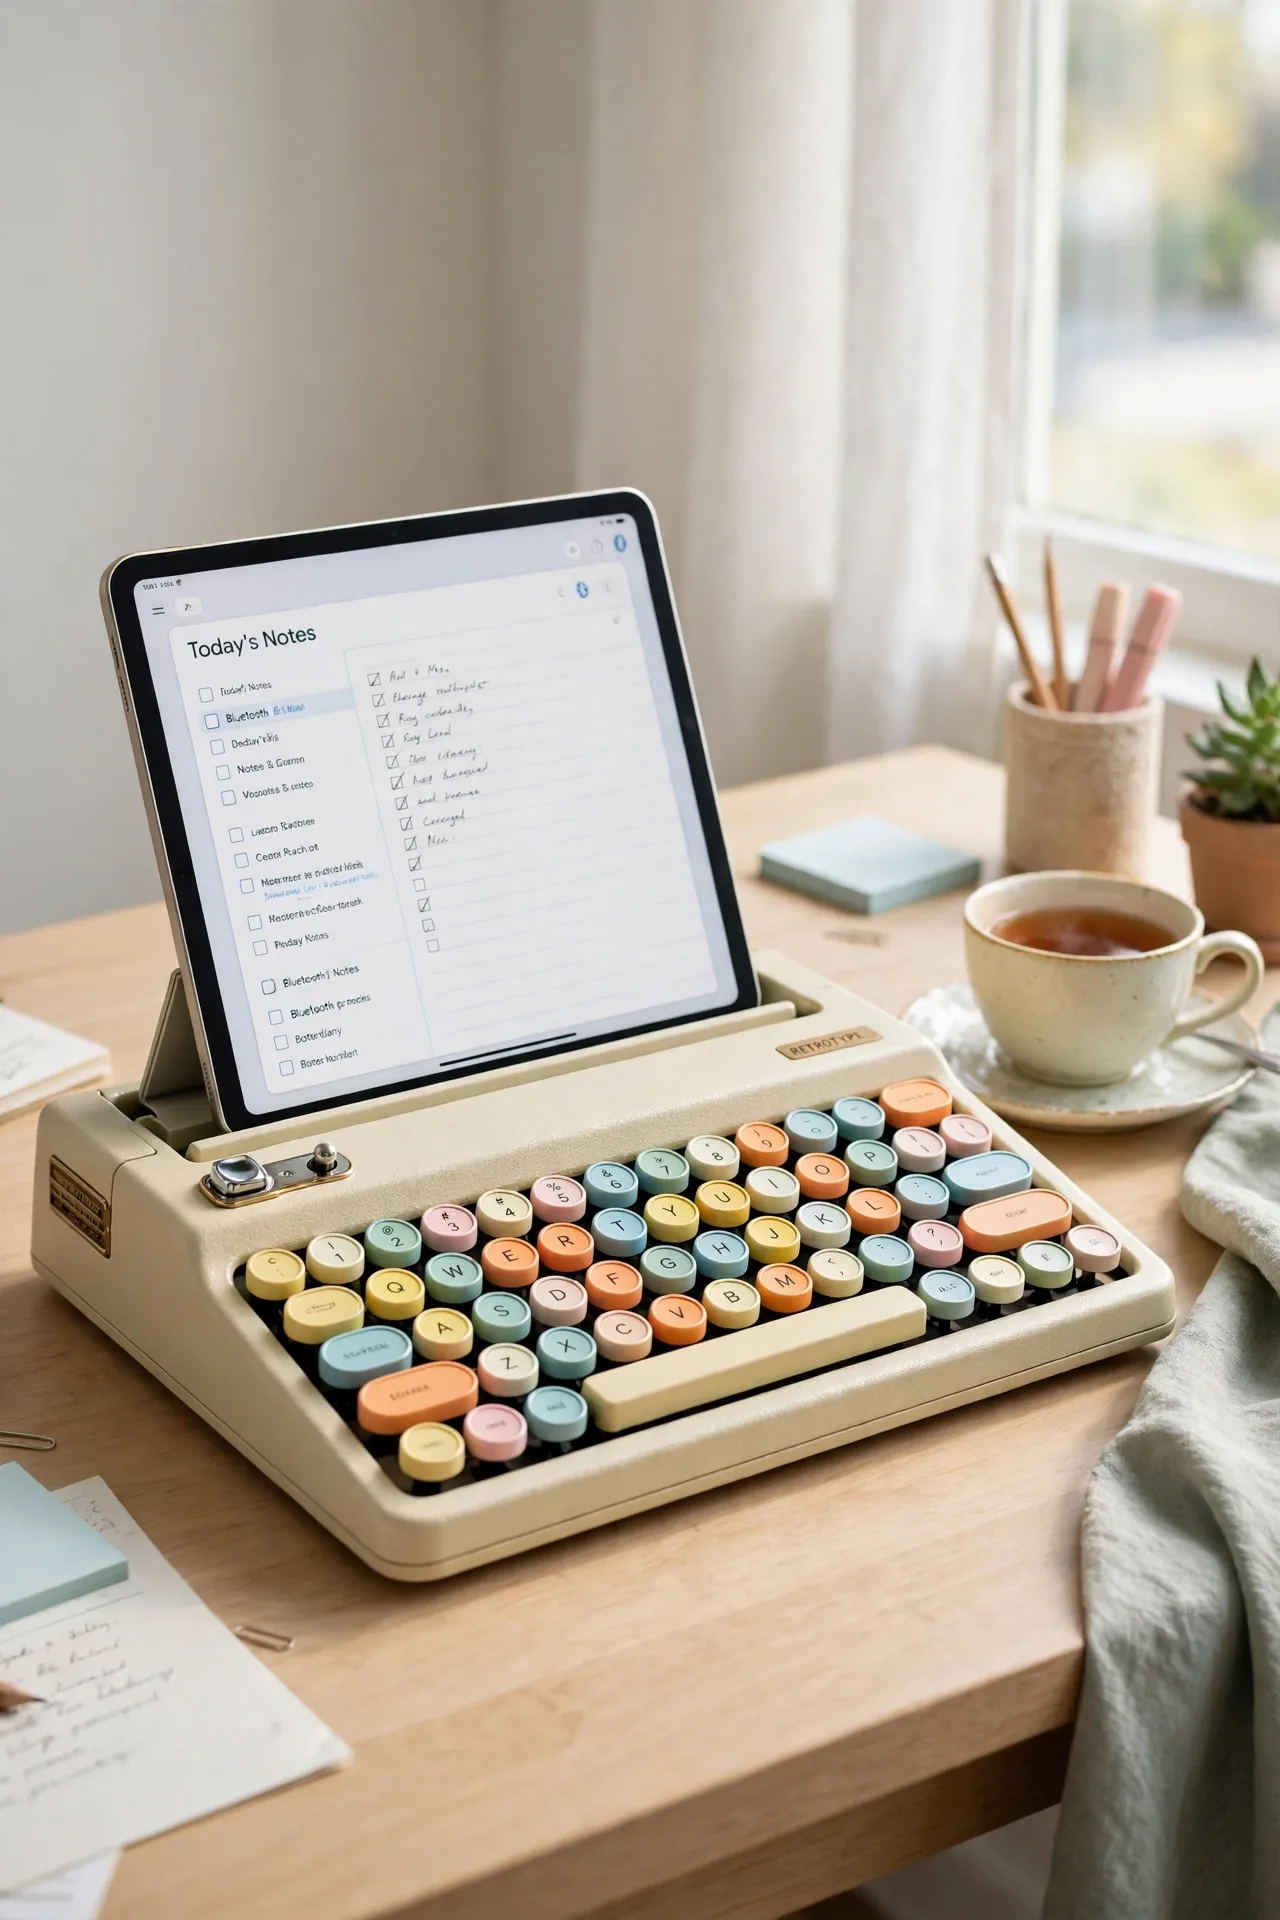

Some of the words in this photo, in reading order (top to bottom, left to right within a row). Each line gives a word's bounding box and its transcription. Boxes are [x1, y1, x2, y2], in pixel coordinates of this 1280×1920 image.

[187, 635, 259, 658] Today's
[263, 629, 317, 647] Notes
[226, 709, 270, 723] Bluetooth
[333, 966, 360, 976] Notes
[291, 1001, 335, 1019] Bluetooth
[761, 1139, 773, 1148] 9
[711, 1152, 724, 1161] 8
[864, 1152, 875, 1161] P
[659, 1165, 670, 1175] 7
[815, 1165, 830, 1174] O
[546, 1182, 562, 1192] %
[611, 1180, 621, 1188] 6
[768, 1179, 778, 1188] I
[557, 1193, 569, 1203] 5
[714, 1192, 730, 1202] U
[663, 1205, 676, 1216] Y
[864, 1200, 883, 1211] L
[506, 1207, 517, 1217] 4
[815, 1214, 833, 1224] K
[449, 1222, 460, 1232] 3
[610, 1219, 626, 1232] T
[769, 1229, 779, 1239] J
[391, 1238, 403, 1246] 2
[556, 1234, 572, 1248] R
[712, 1242, 730, 1254] H
[335, 1253, 345, 1262] 1
[502, 1249, 520, 1262] E
[661, 1258, 676, 1268] G
[441, 1264, 464, 1278] W
[605, 1272, 620, 1285] F
[775, 1275, 795, 1287] M
[386, 1281, 405, 1294] Q
[549, 1290, 566, 1301] D
[723, 1291, 740, 1303] B
[493, 1304, 510, 1317] S
[669, 1307, 684, 1318] V
[438, 1323, 452, 1334] A
[616, 1324, 632, 1334] C
[558, 1340, 576, 1352] X
[501, 1357, 517, 1369] Z
